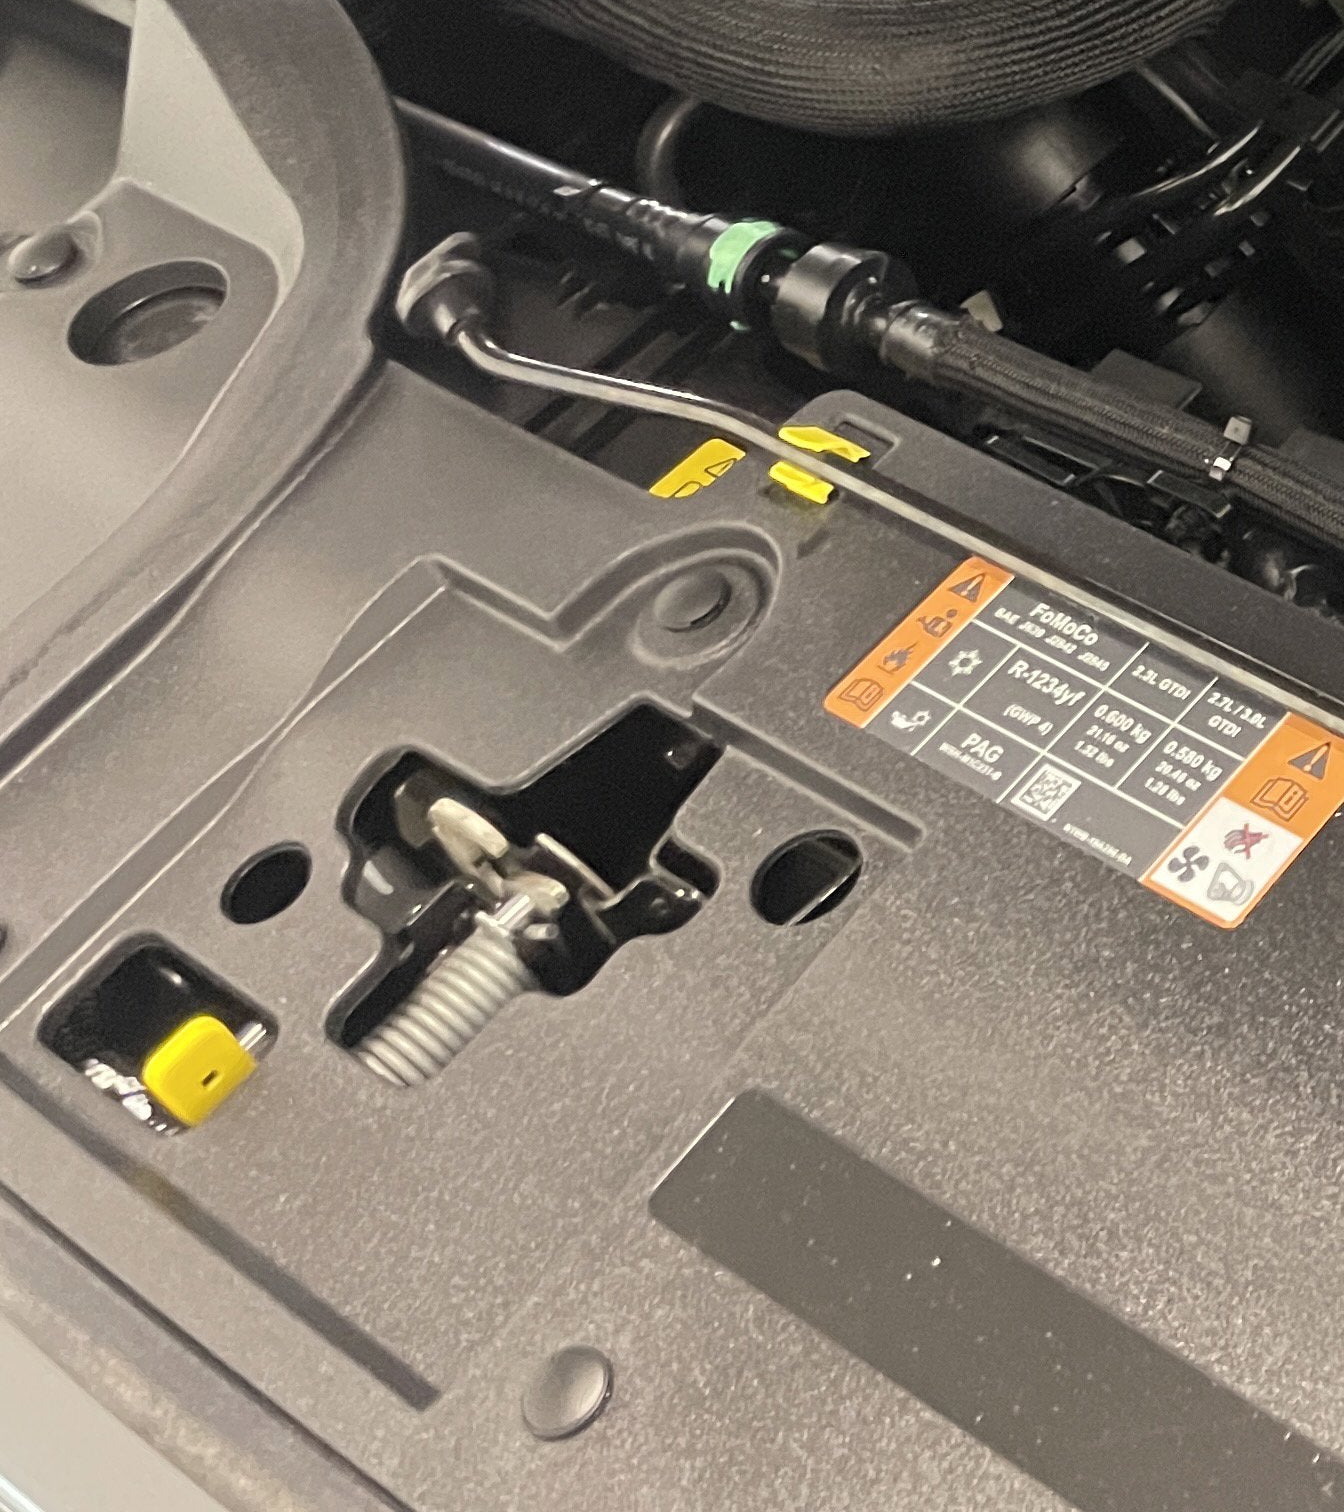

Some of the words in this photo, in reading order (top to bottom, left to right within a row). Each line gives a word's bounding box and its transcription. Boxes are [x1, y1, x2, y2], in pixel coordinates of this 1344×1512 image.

[1029, 603, 1099, 645] FoMoCo
[1007, 660, 1086, 706] R-1234yf
[1131, 664, 1158, 685] 2.3L
[1158, 678, 1192, 700] GTDI
[1002, 704, 1041, 726] (GWP
[1094, 704, 1134, 732] 0.600
[1130, 723, 1152, 744] kg
[1207, 692, 1234, 713] 2.7L
[1240, 707, 1267, 729] 3.0L
[1207, 714, 1242, 738] GTDI
[961, 733, 1004, 763] PAG
[1163, 740, 1205, 769] 0.580
[1201, 760, 1223, 782] kg
